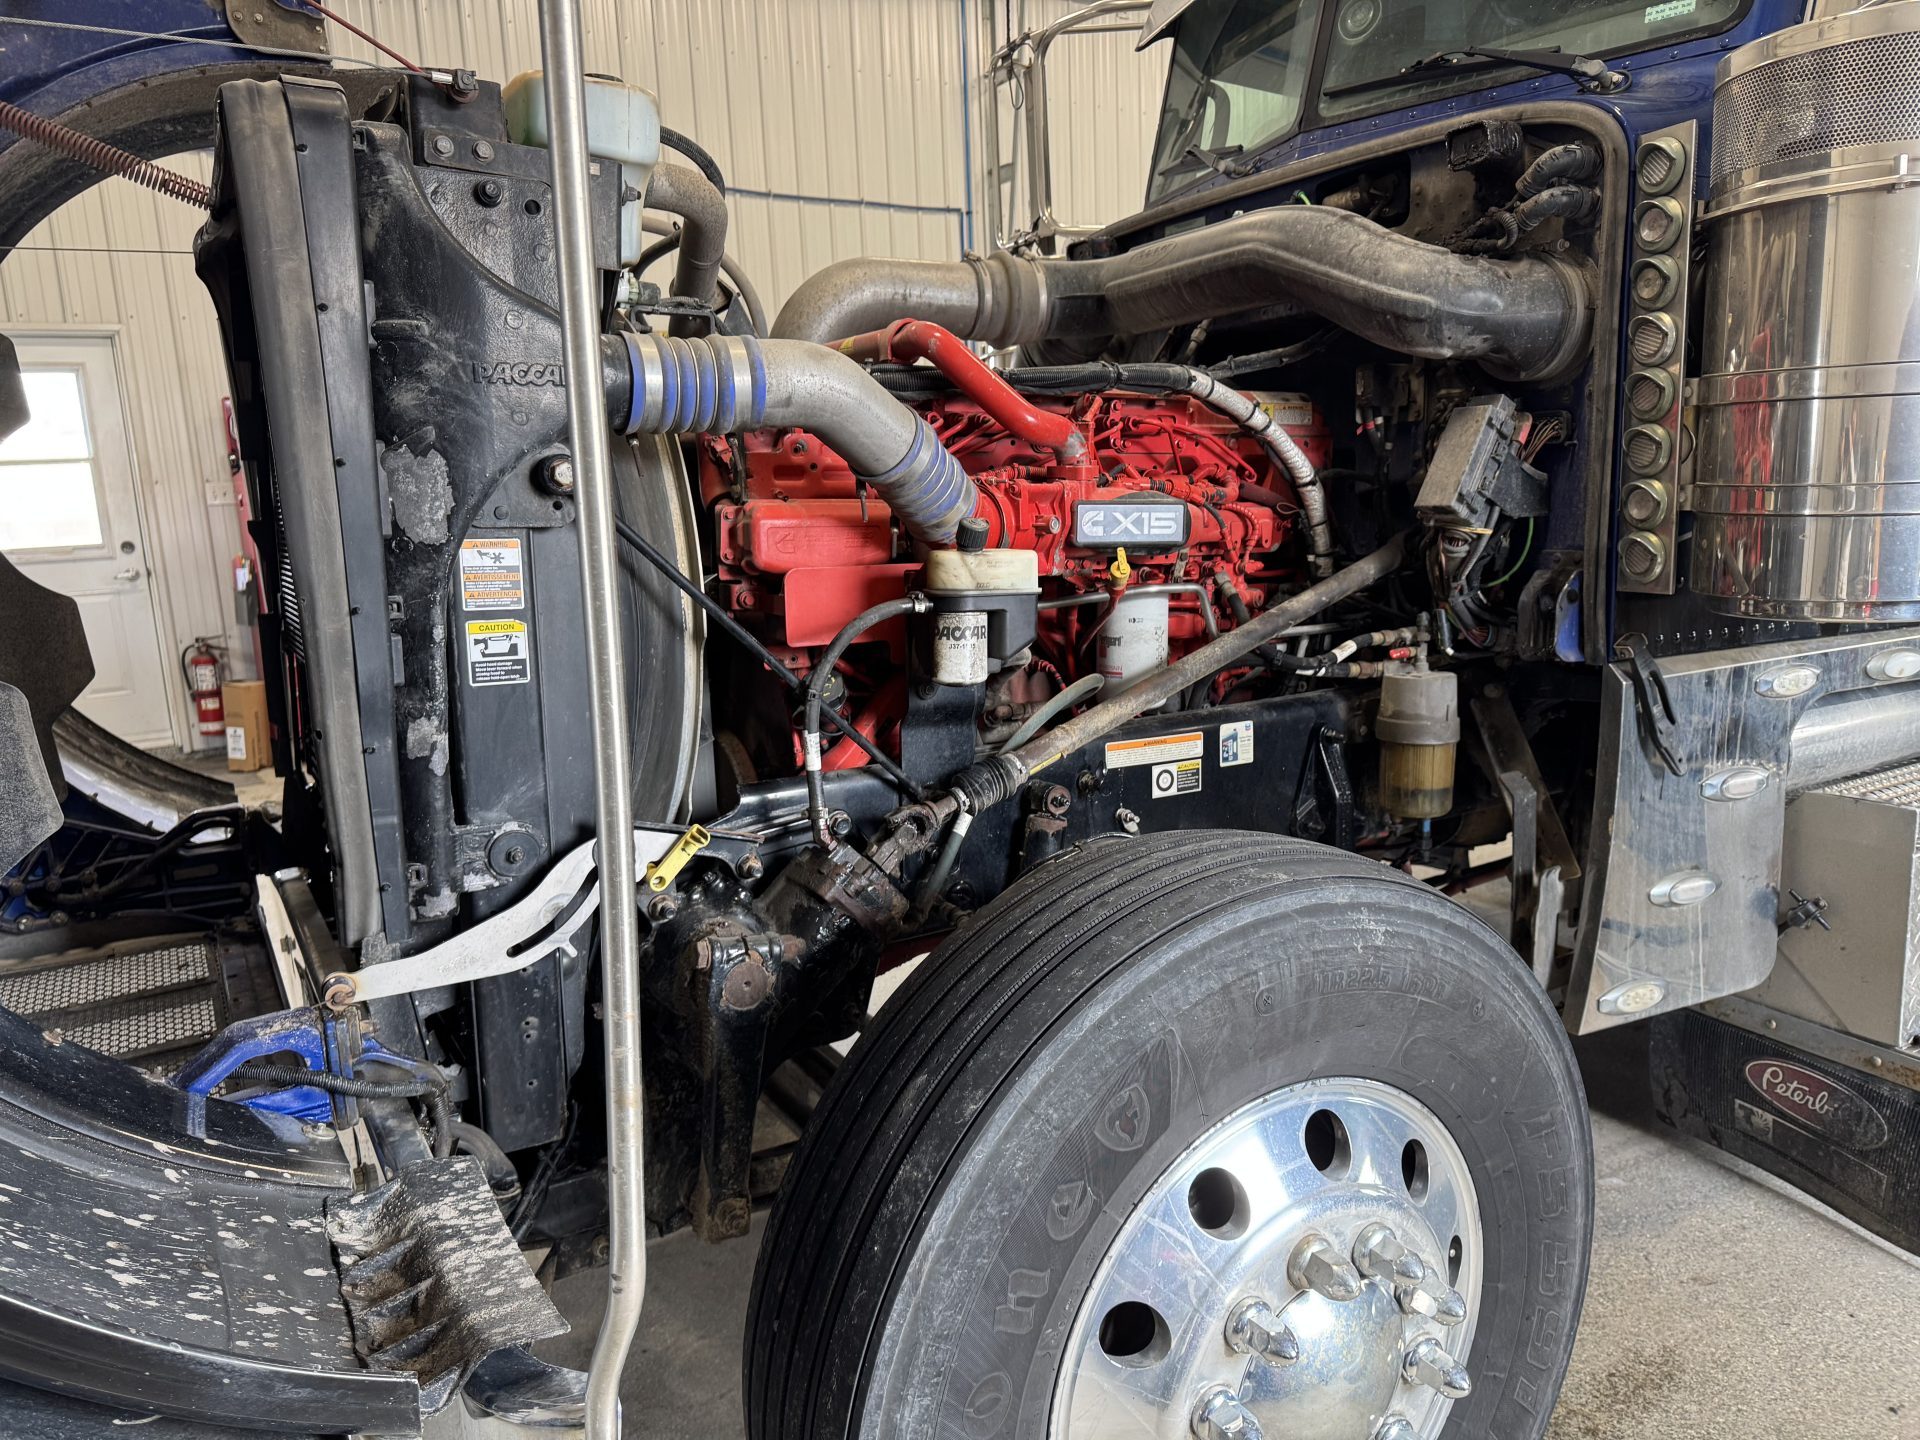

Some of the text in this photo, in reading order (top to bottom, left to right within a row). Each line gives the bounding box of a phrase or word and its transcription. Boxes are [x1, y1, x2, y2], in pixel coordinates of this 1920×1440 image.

[1110, 511, 1178, 535] X15
[479, 624, 514, 632] CAUTION
[1761, 1066, 1838, 1116] Peterb
